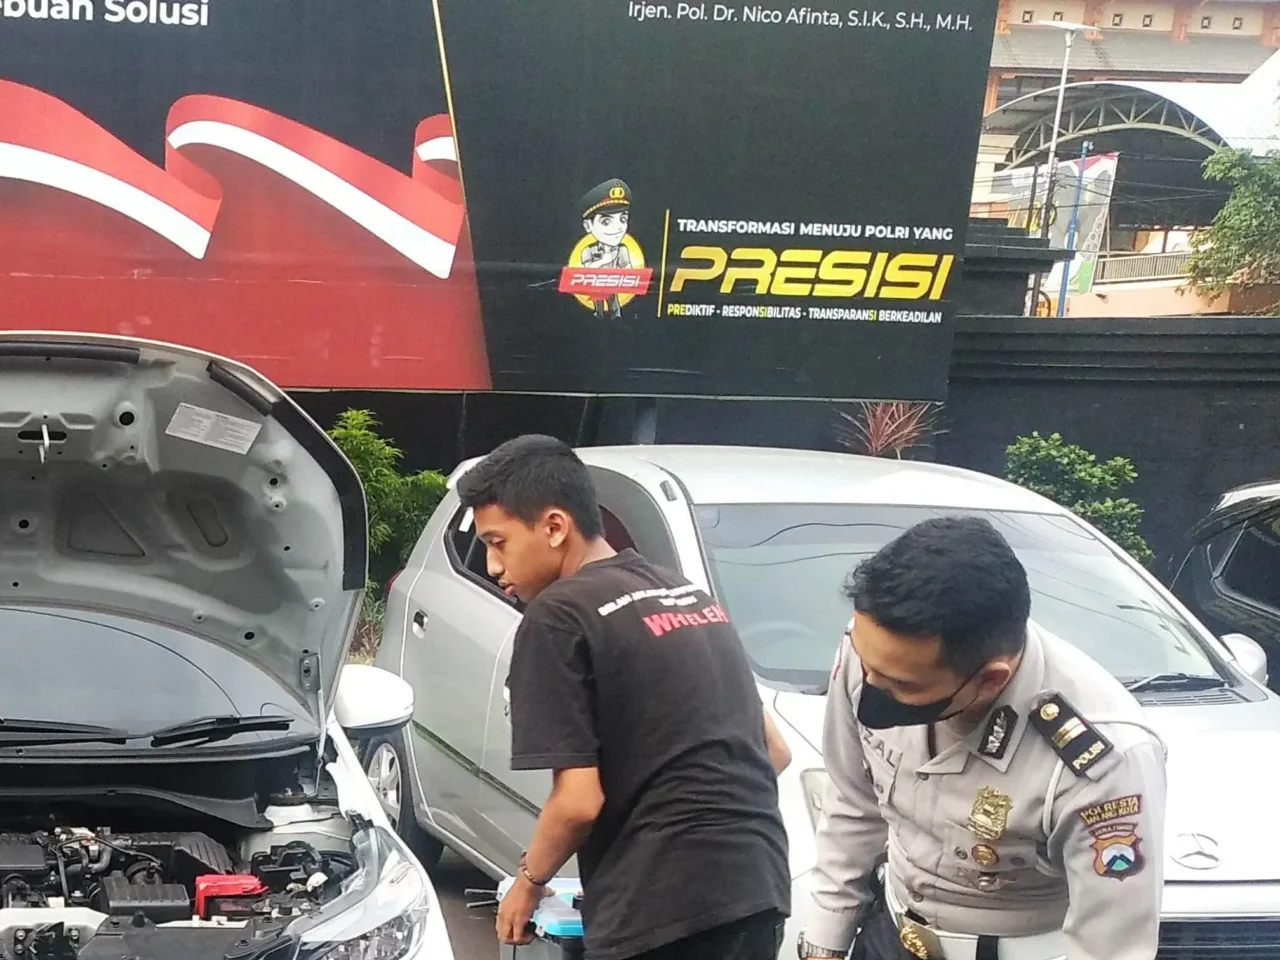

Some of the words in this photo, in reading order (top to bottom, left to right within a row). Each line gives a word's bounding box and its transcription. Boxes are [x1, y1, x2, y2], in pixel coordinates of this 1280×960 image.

[104, 0, 210, 26] Solusi
[628, 1, 672, 22] Irjen.
[676, 3, 708, 20] Pol.
[713, 5, 738, 22] Dr.
[743, 6, 782, 23] Nico
[785, 7, 843, 28] Afinta,
[847, 10, 890, 30] S.I.K.,
[895, 12, 931, 31] S.H.,
[936, 13, 973, 31] M.H.
[677, 219, 795, 234] TRANSFORMASI
[799, 222, 862, 237] MENUJU
[864, 225, 910, 239] POLRI
[913, 227, 954, 240] YANG
[570, 273, 641, 288] PRESISI
[670, 245, 954, 300] PRESISI
[667, 304, 716, 316] PREDIKTIF
[722, 305, 802, 319] RESPONSIBILITAS
[808, 307, 877, 321] TRANSPARANSI
[878, 310, 942, 323] BERKEADILAN
[1072, 740, 1106, 771] POLISI
